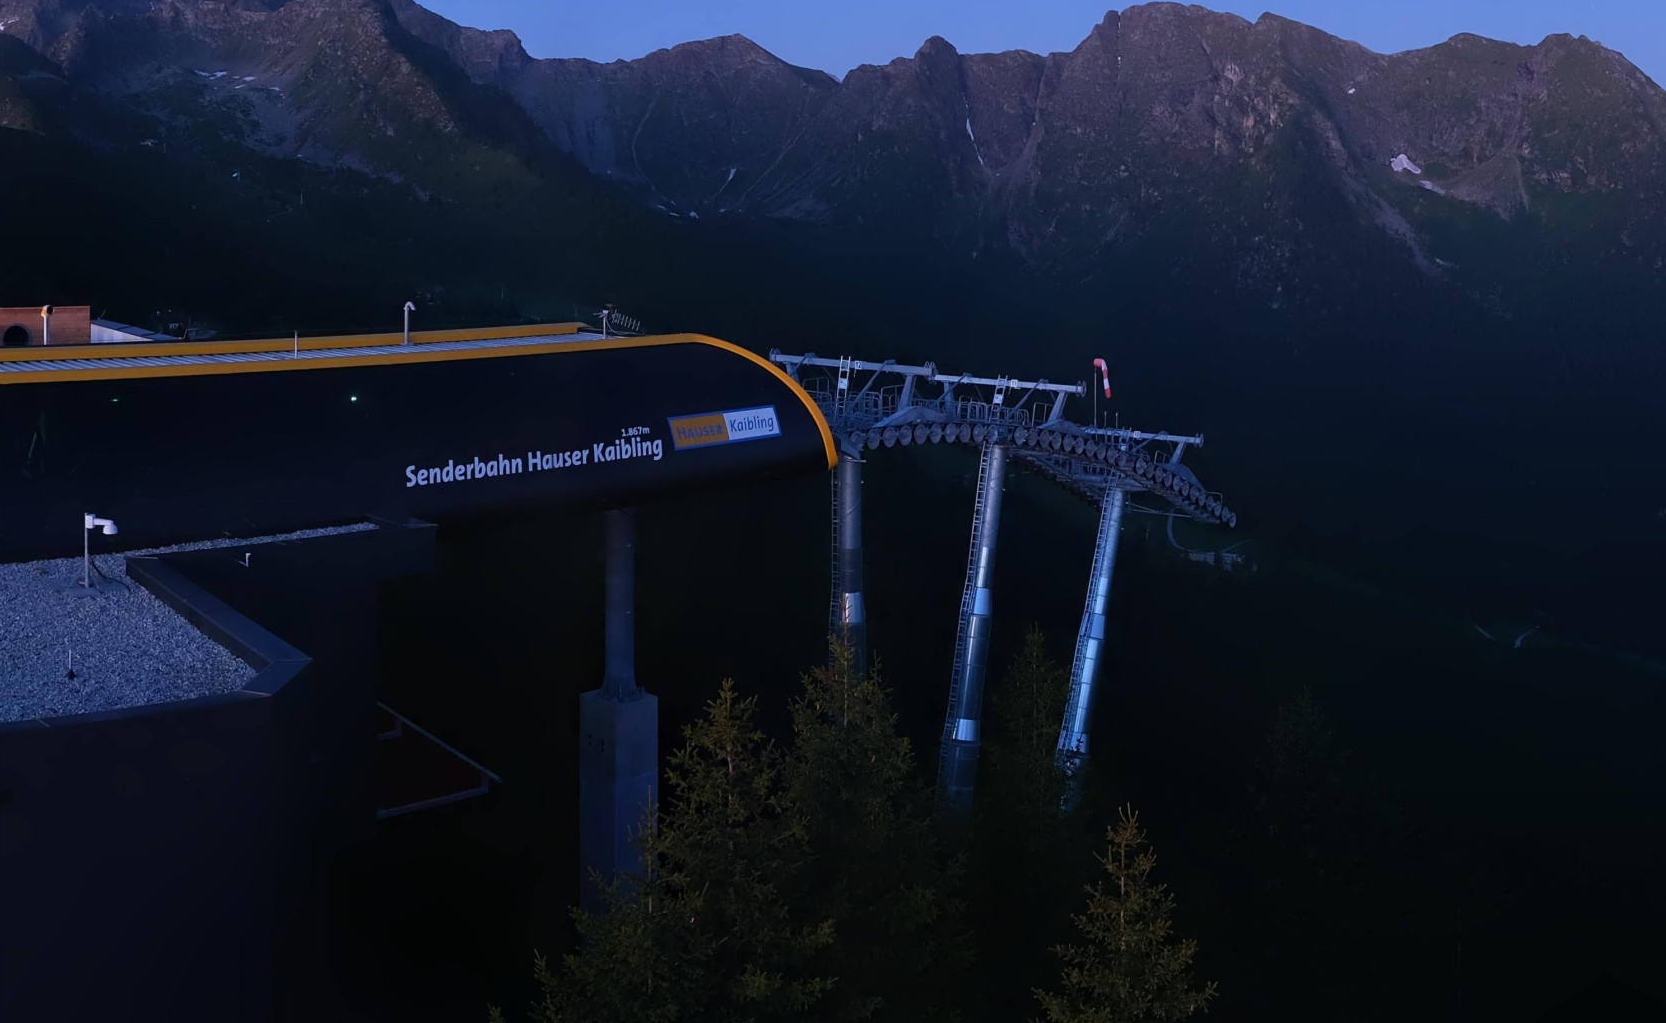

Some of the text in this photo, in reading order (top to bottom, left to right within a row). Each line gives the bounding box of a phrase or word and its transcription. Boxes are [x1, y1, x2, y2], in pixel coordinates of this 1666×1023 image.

[620, 425, 651, 438] 1.867m
[677, 415, 774, 440] HAUSER Kaibling
[405, 436, 663, 487] Senderbahn Hauser Kaibling
